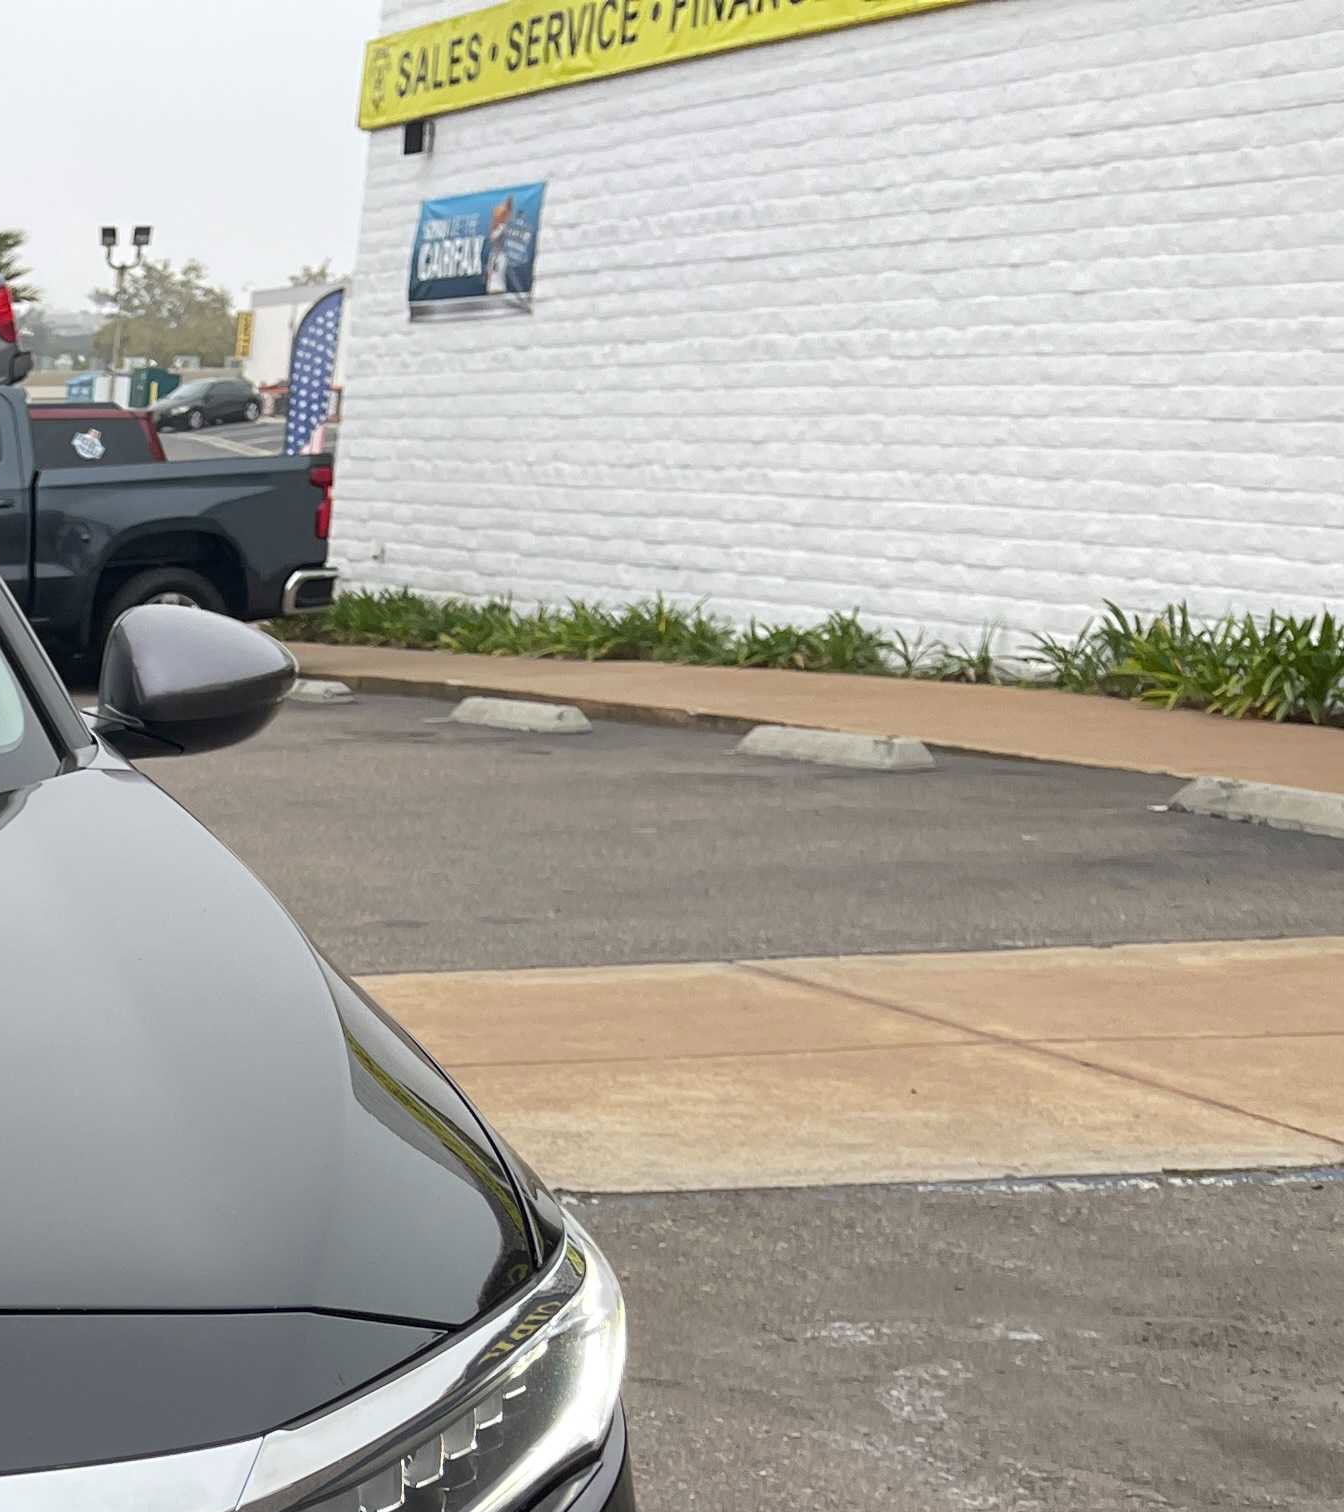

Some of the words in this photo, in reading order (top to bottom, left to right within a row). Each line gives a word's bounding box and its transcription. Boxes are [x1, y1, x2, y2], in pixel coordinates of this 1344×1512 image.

[395, 33, 482, 97] SALES
[506, 0, 638, 71] SERVICE
[416, 235, 485, 281] CARFAX
